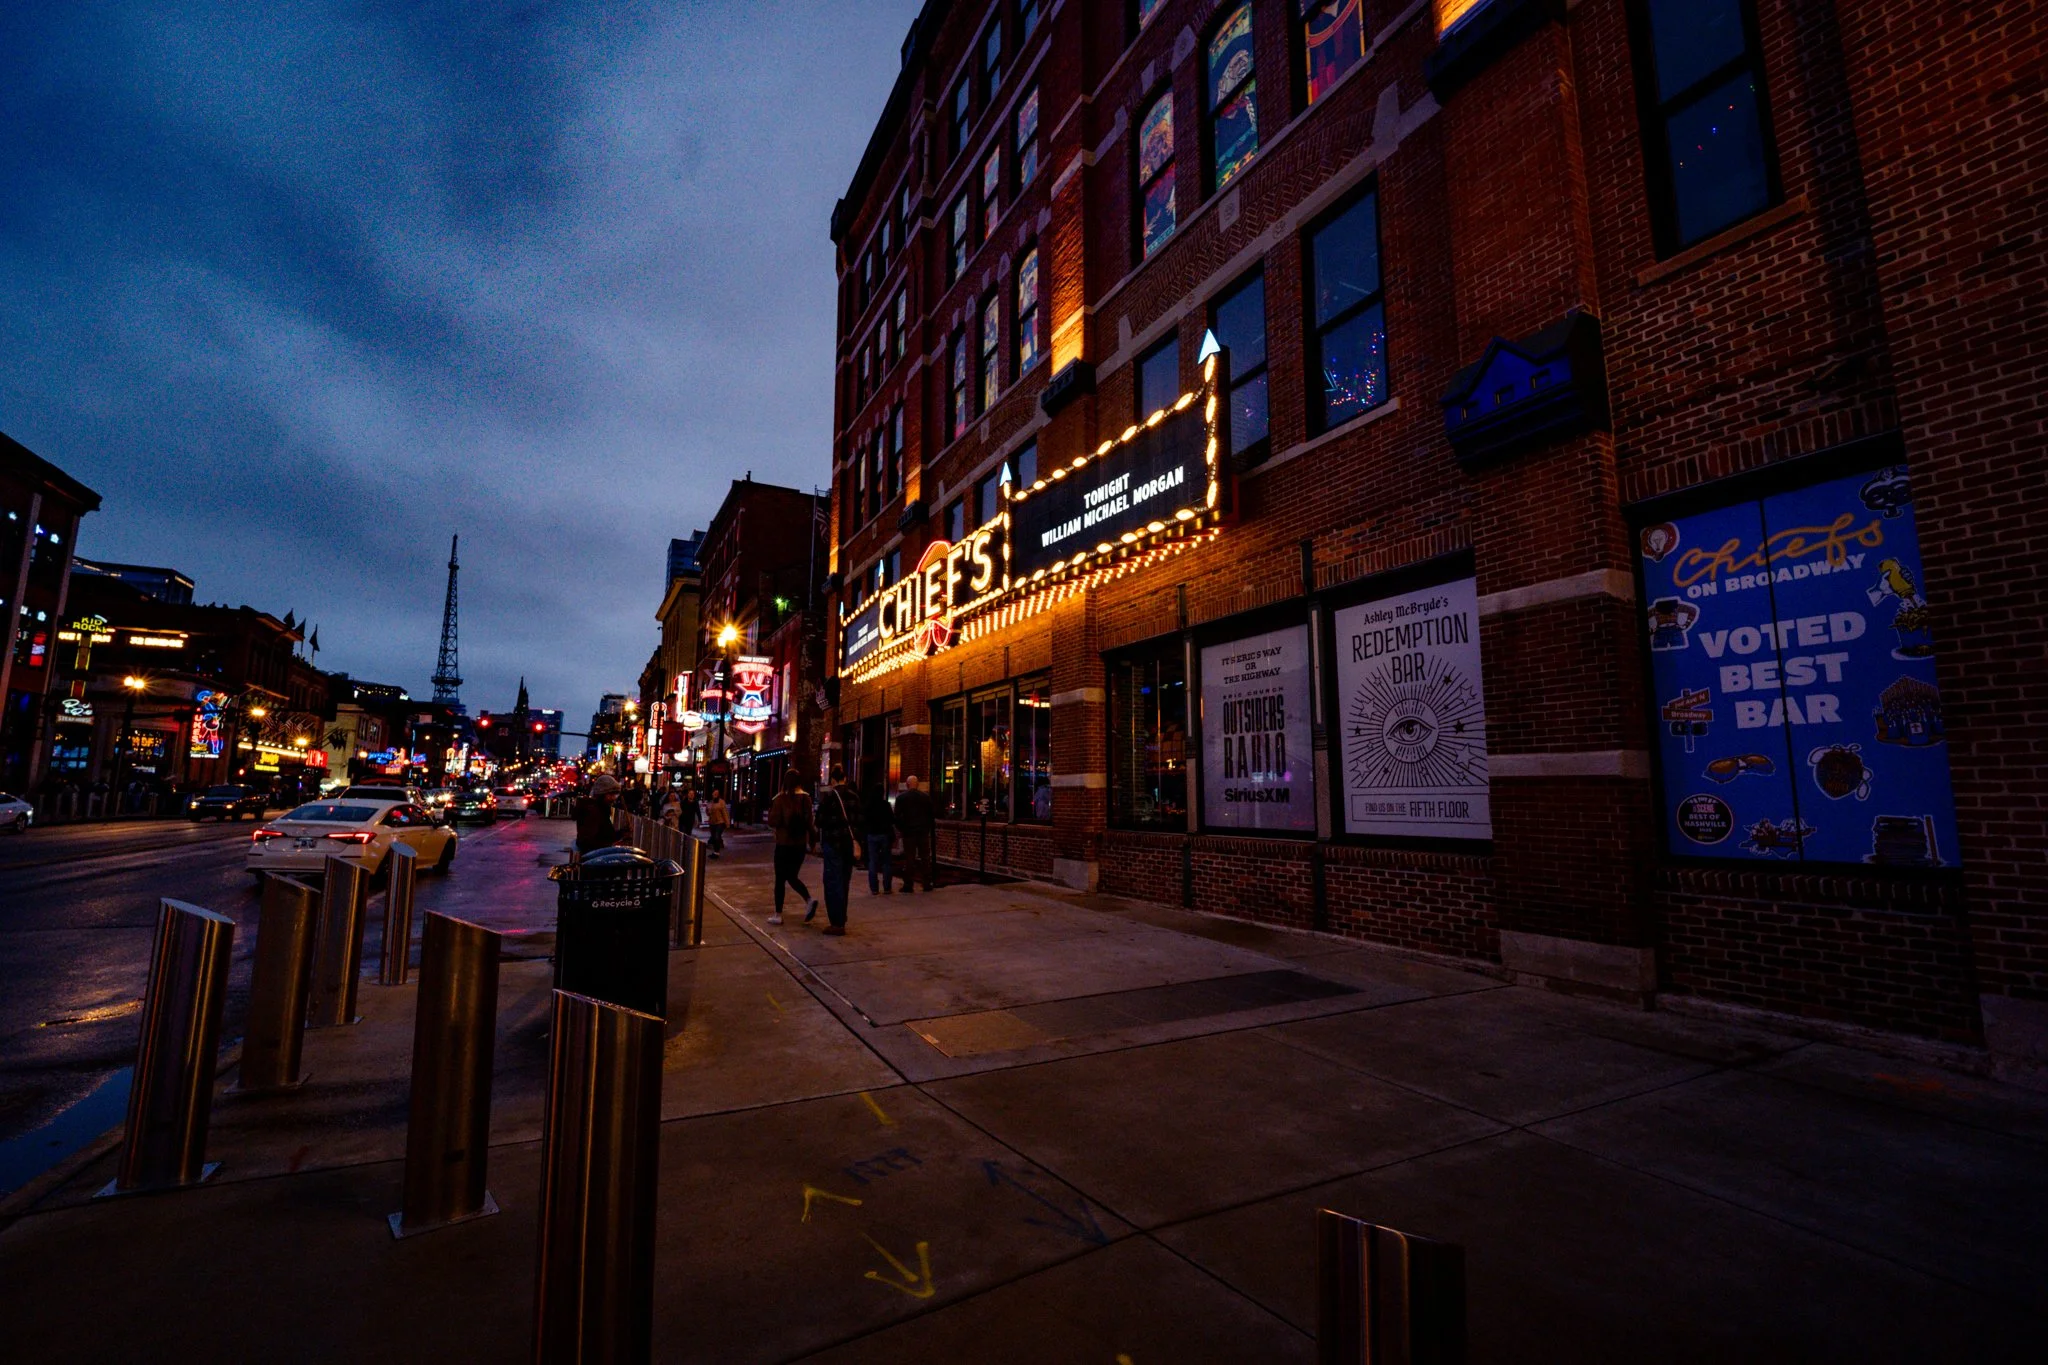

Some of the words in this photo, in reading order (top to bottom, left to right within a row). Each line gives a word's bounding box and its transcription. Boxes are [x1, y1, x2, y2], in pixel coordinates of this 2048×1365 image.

[1041, 516, 1082, 548] WILLIAM
[1084, 495, 1130, 529] MICHAEL
[1133, 465, 1184, 506] MORGAN
[1083, 472, 1131, 509] TONIGHT
[880, 530, 993, 640] CHIEF'S
[1686, 581, 1718, 599] ON
[1725, 553, 1866, 592] BROADWAY
[1363, 610, 1394, 625] Ashley
[1395, 596, 1449, 619] McBryde's
[1352, 612, 1469, 663] REDEMPTION
[1698, 611, 1866, 659] VOTED
[1244, 662, 1257, 672] OR
[1262, 646, 1283, 659] WAY
[1391, 652, 1427, 685] BAR
[1223, 674, 1241, 685] THE
[1241, 667, 1282, 681] HIGHWAY
[1720, 652, 1849, 694] BEST
[1246, 686, 1285, 697] CHURCH
[1222, 695, 1286, 735] OUTSIDERS
[1735, 693, 1843, 729] BAR
[1223, 732, 1288, 779] RADIO
[1224, 787, 1291, 803] SiriusXM
[1409, 801, 1436, 818] FIFTH
[1438, 801, 1471, 819] FLOOR
[1684, 820, 1727, 829] NASHVILLE
[600, 899, 633, 910] Recycle
